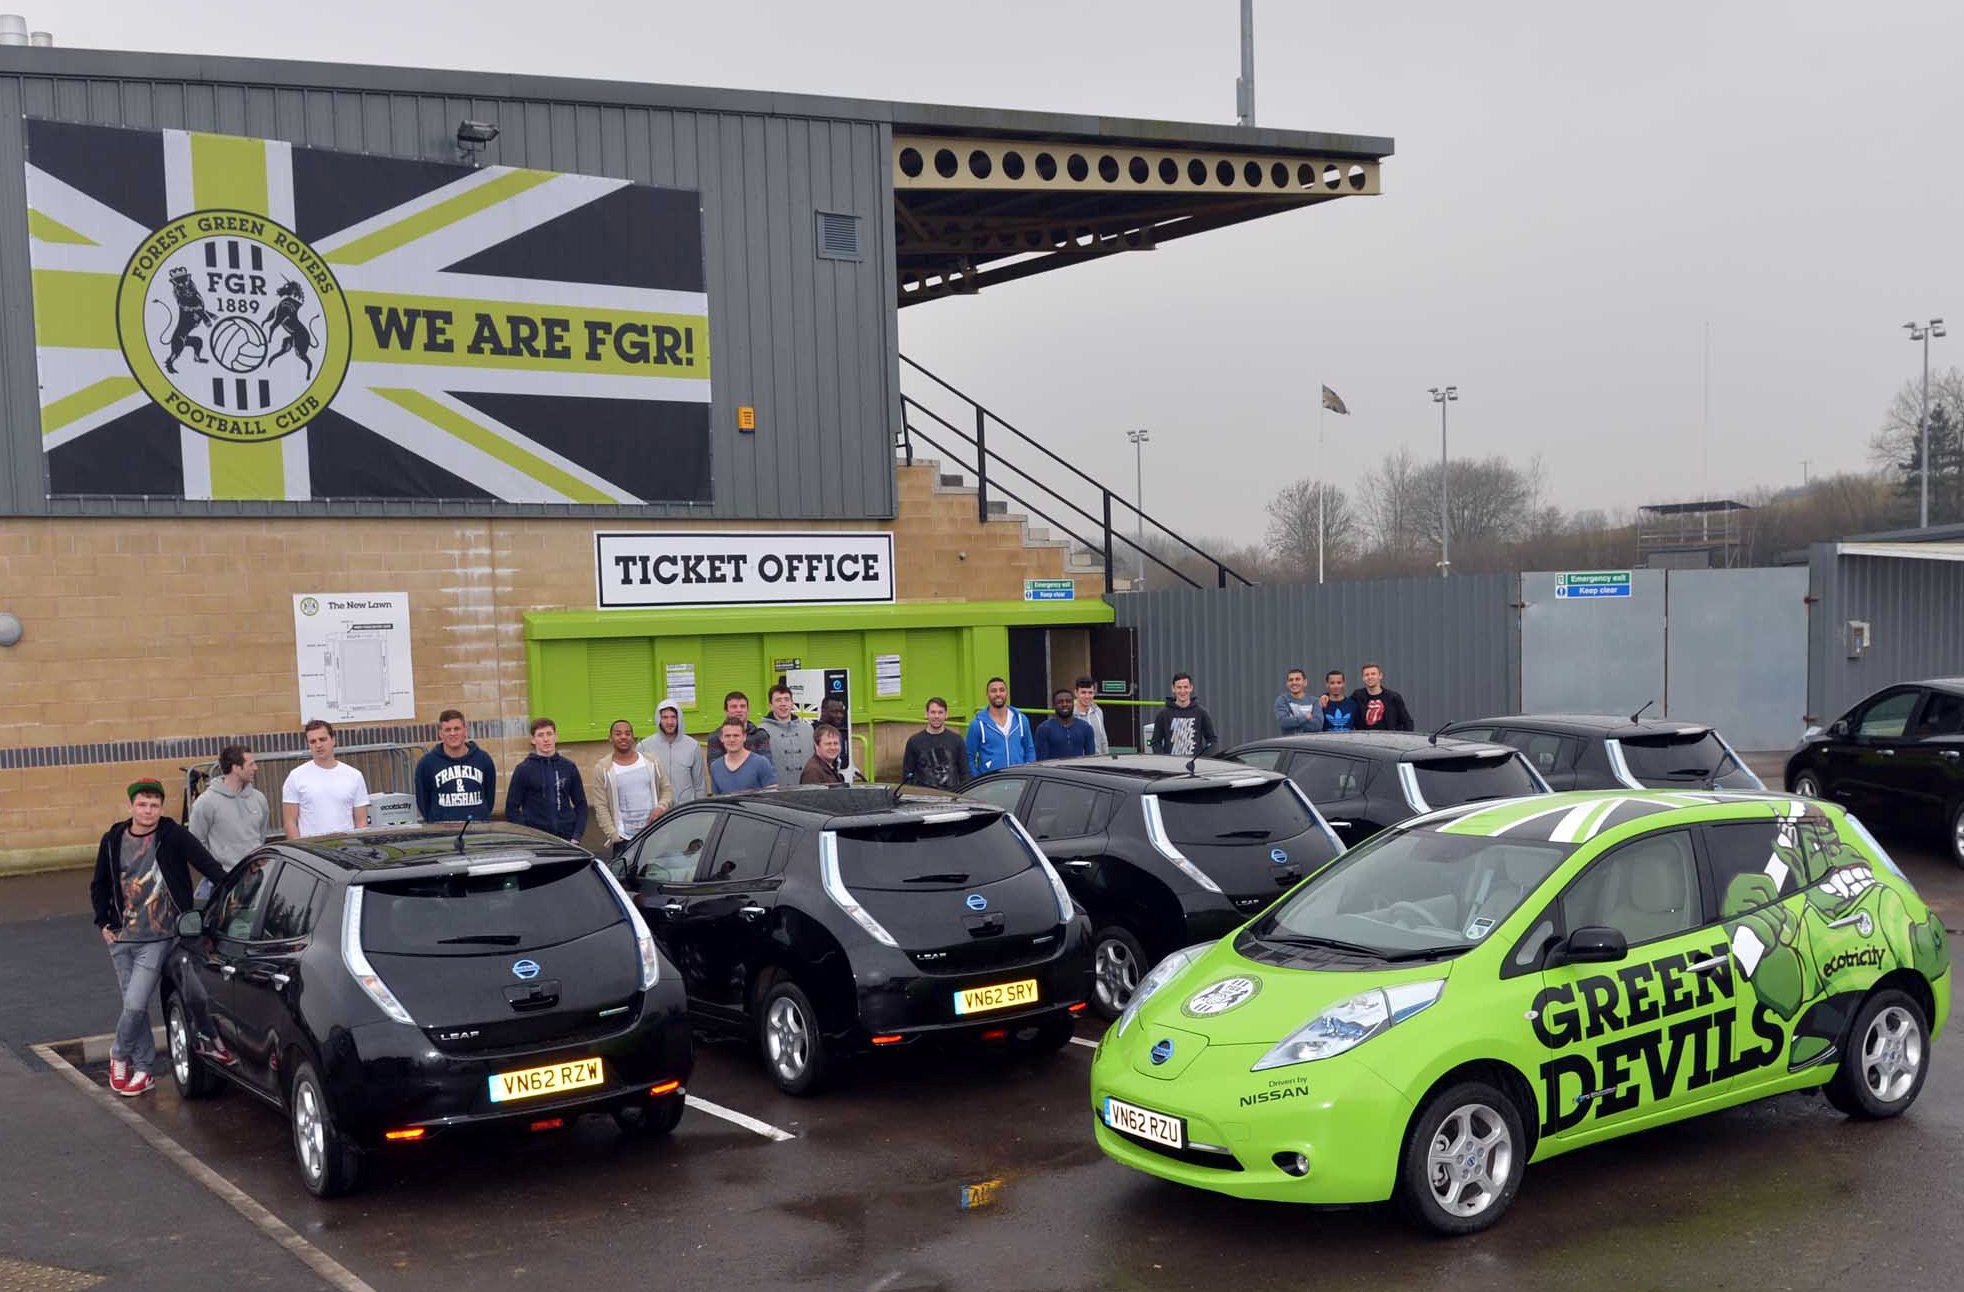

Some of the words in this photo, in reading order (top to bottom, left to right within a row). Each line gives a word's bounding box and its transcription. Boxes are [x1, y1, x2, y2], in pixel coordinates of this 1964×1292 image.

[132, 224, 188, 281] FOREST
[197, 216, 266, 236] GREEN
[273, 232, 334, 295] ROVERS
[206, 272, 267, 295] FGR
[217, 297, 260, 314] 1889
[364, 305, 454, 353] WE
[467, 313, 571, 359] ARE
[584, 320, 694, 367] FGR!
[165, 391, 267, 436] FOOTBALL
[275, 395, 320, 429] CLUB
[614, 554, 748, 585] TICKET
[757, 553, 880, 583] OFFICE
[1570, 575, 1612, 583] Emergency
[1579, 587, 1599, 595] Keep
[328, 602, 345, 610] The
[346, 601, 367, 609] New
[367, 601, 393, 609] Lawn
[1171, 717, 1196, 730] NIKE
[435, 764, 484, 788] FRANKLIN
[456, 778, 465, 793] &
[438, 791, 483, 807] MARSHALL
[917, 952, 947, 961] LEAF
[1823, 944, 1886, 978] ecotricity
[965, 987, 1004, 1009] VN62
[1006, 982, 1035, 1002] SRY
[1531, 942, 1738, 1050] GREEN
[440, 1030, 480, 1041] LEAF
[503, 1069, 557, 1095] VN62
[560, 1062, 598, 1084] RZW
[1539, 1001, 1785, 1139] DEVILS
[1268, 1079, 1296, 1088] Driven
[1297, 1076, 1308, 1085] by
[1240, 1085, 1309, 1108] NISSAN
[1112, 1103, 1146, 1134] VN62
[1150, 1116, 1179, 1144] RZU
